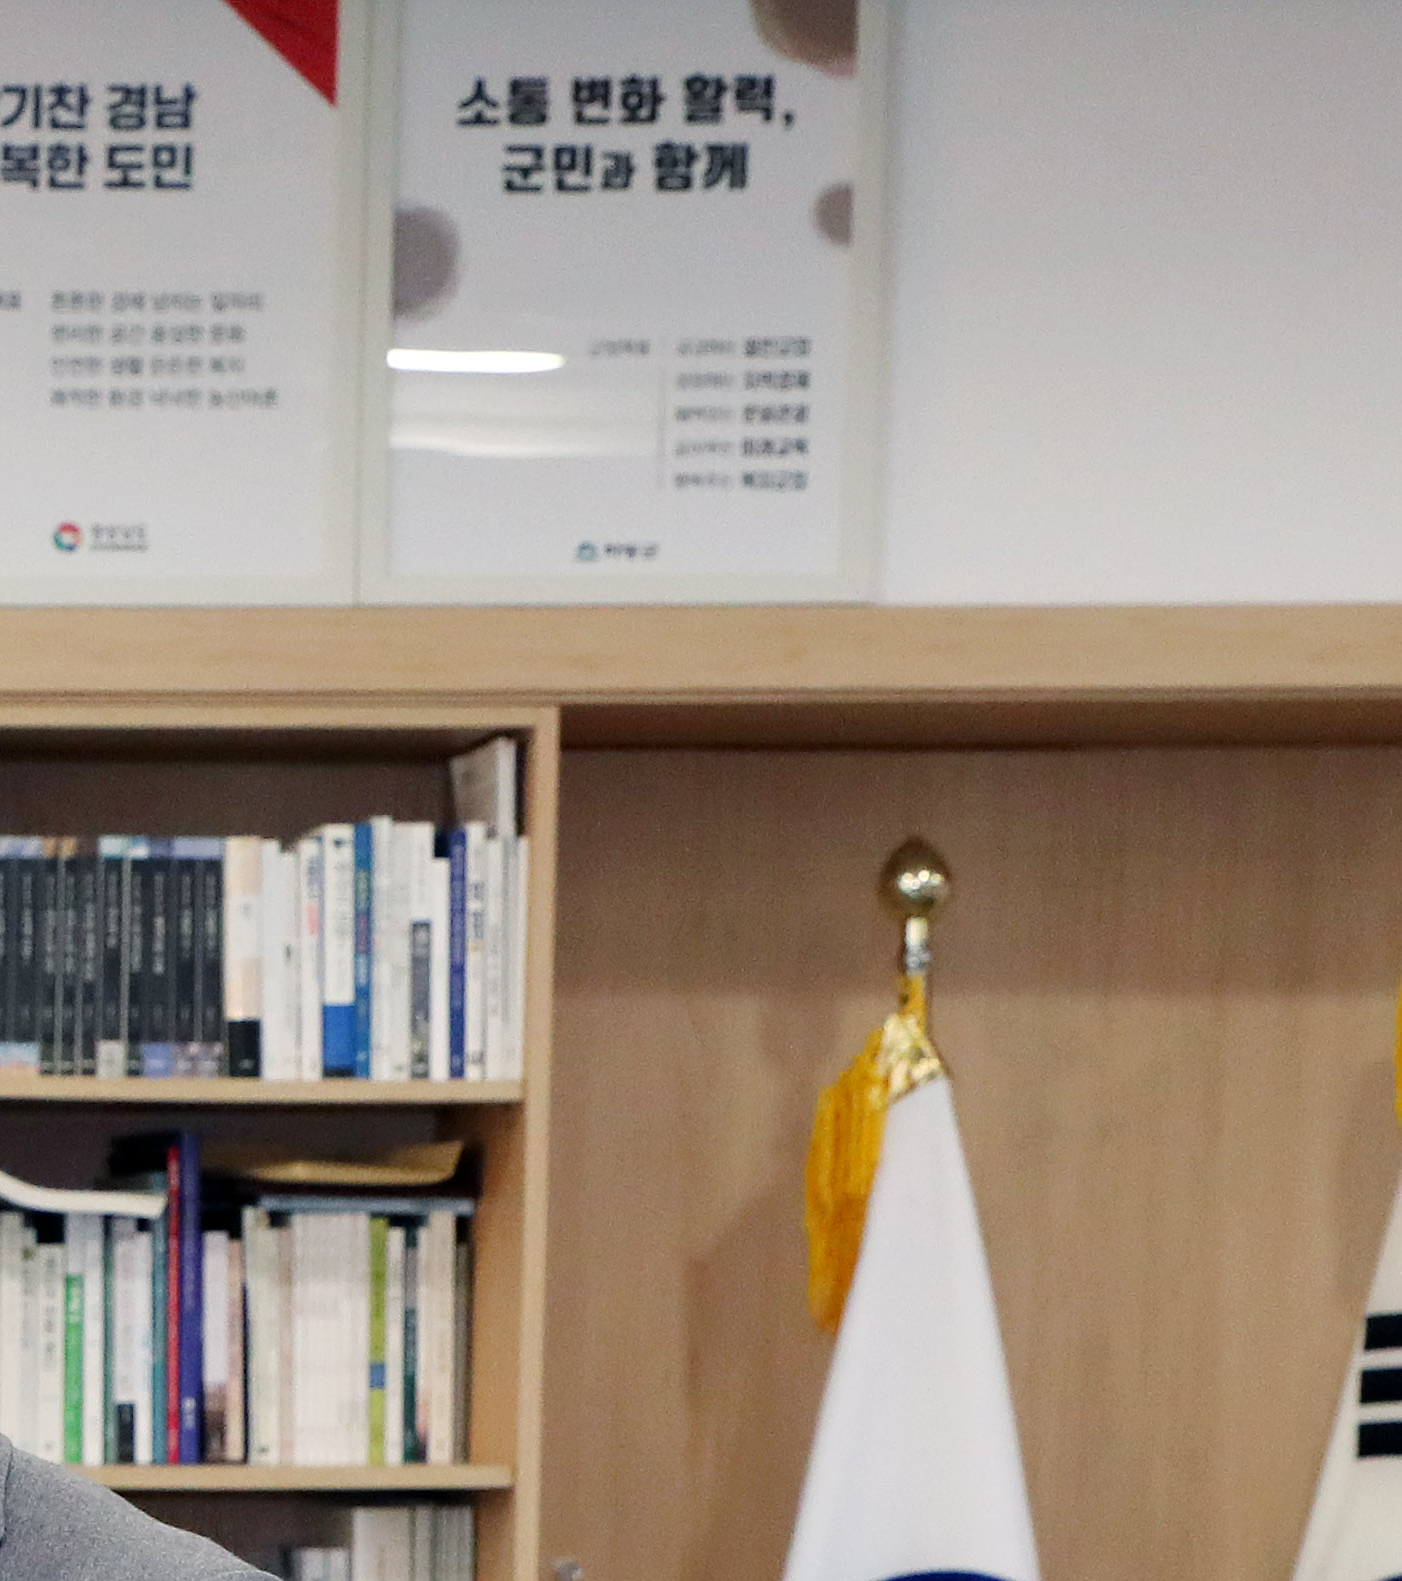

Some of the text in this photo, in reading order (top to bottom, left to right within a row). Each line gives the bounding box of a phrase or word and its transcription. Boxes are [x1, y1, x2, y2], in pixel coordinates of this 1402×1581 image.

[106, 82, 197, 131] 경남
[457, 73, 795, 130] 소통 변화 활력,
[103, 143, 194, 191] 도민
[503, 141, 749, 193] 군민과 함께
